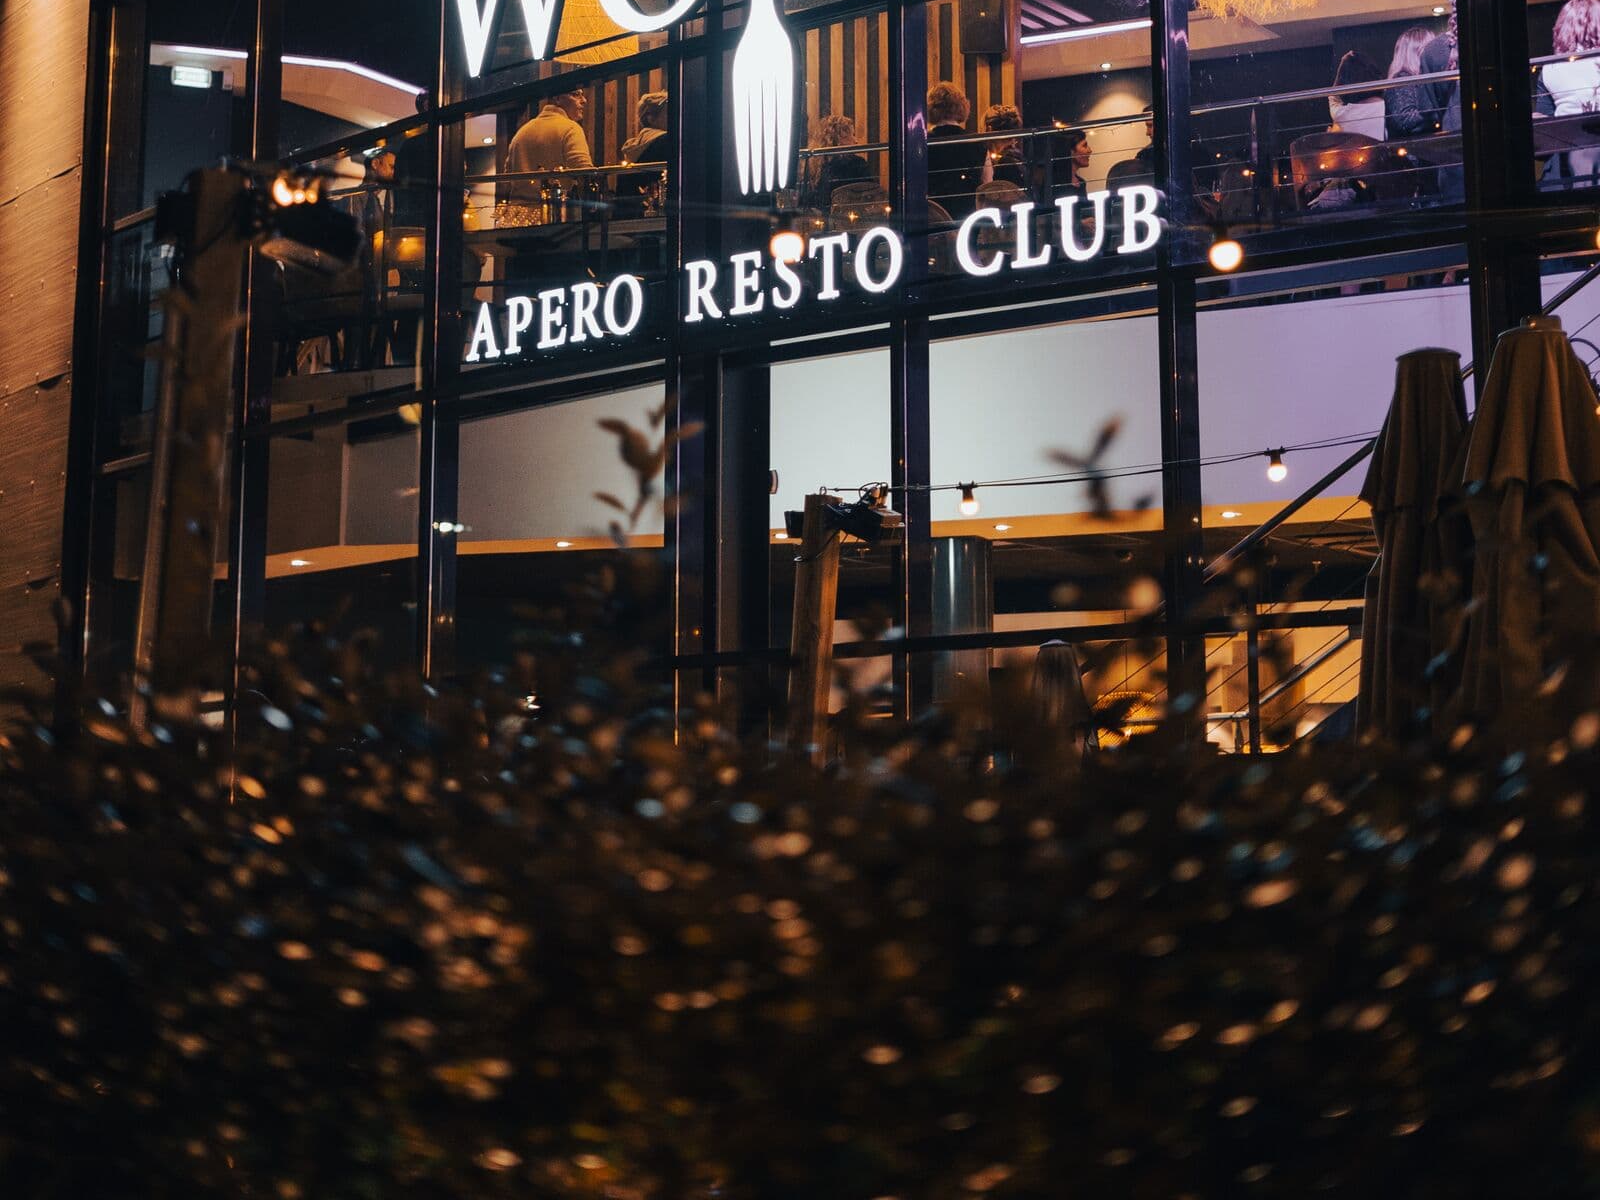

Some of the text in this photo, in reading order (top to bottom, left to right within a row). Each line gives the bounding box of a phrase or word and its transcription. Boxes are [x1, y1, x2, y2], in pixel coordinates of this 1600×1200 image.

[465, 184, 1163, 362] APERO RESTO CLUB
